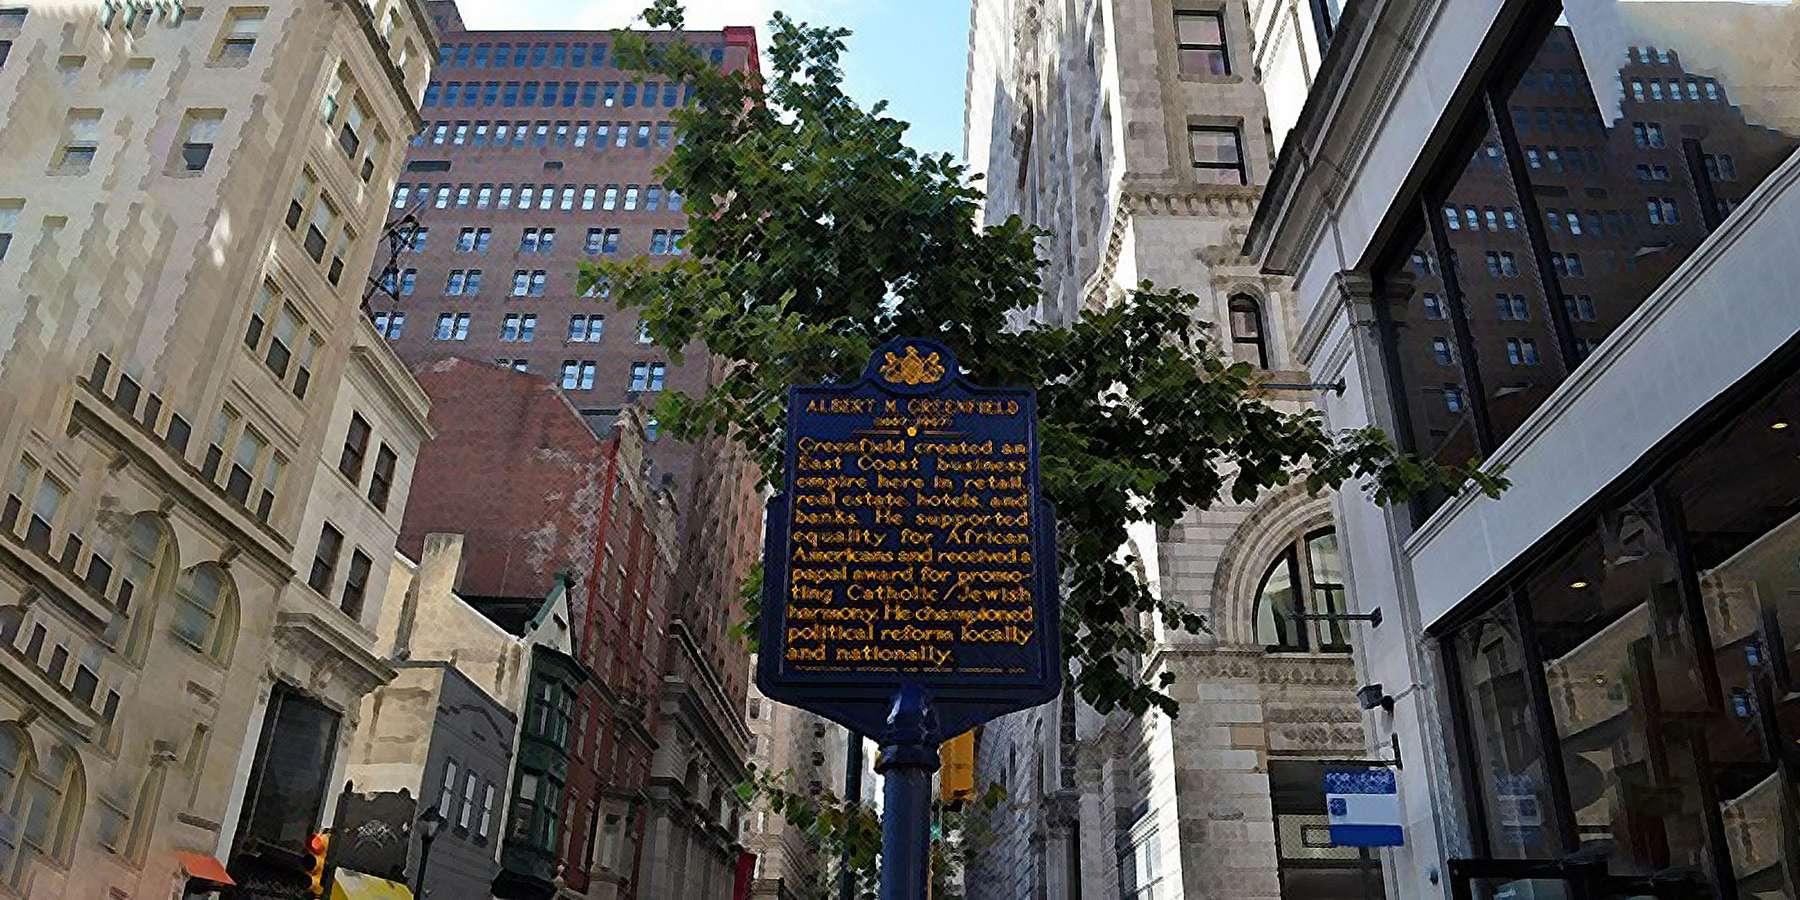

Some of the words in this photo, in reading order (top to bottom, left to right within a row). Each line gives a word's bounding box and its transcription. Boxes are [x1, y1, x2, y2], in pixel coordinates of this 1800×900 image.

[915, 440, 993, 454] created
[1002, 443, 1026, 454] an
[799, 456, 841, 470] East
[858, 456, 918, 470] Coast
[937, 457, 1026, 471] business
[797, 476, 866, 491] empire
[878, 473, 924, 488] here
[934, 476, 952, 488] in
[797, 492, 835, 506] real
[991, 494, 1027, 507] and
[876, 508, 902, 524] He
[916, 512, 1028, 527] supported
[794, 530, 886, 547] equality
[901, 529, 933, 544] for
[946, 526, 1028, 544] African
[793, 547, 893, 562] Americans
[898, 548, 932, 562] and
[938, 549, 1016, 562] received
[1021, 552, 1030, 562] a
[792, 567, 846, 583] papal
[853, 567, 912, 581] award
[921, 567, 951, 581] for
[792, 584, 832, 603] ting
[884, 605, 912, 621] He
[789, 624, 873, 642] political
[881, 625, 953, 640] reform
[962, 624, 1032, 645] locally
[786, 644, 825, 660] and
